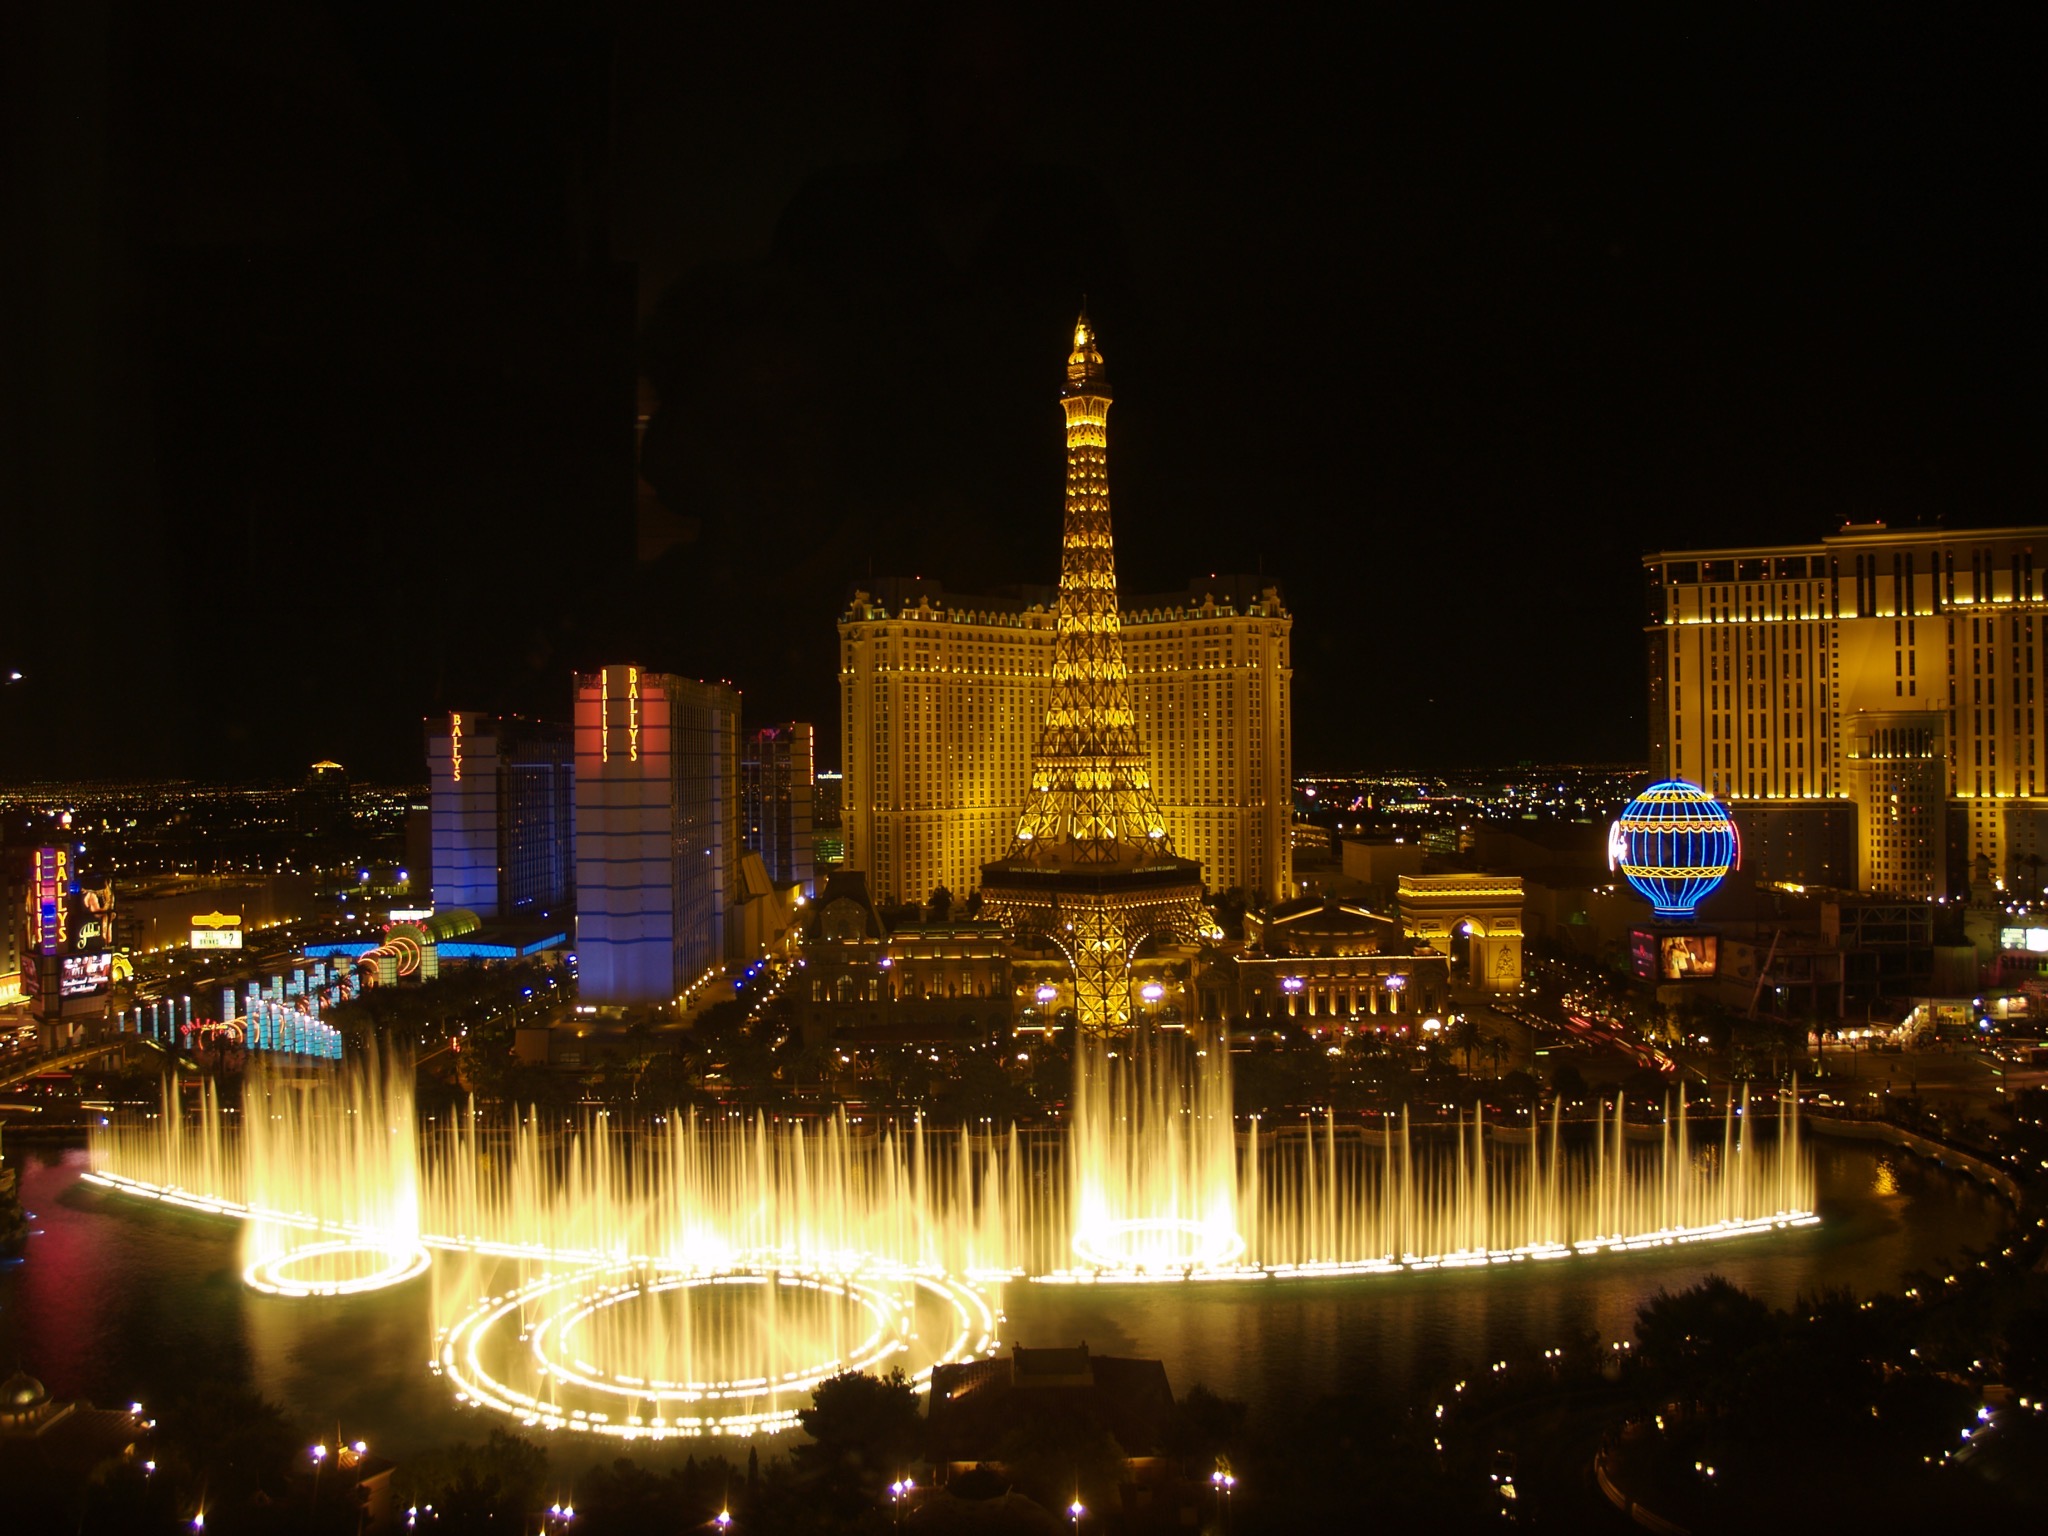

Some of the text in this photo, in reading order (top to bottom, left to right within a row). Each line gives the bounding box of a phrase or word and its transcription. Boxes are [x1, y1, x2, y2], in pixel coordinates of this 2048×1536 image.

[451, 714, 462, 782] BALLYS
[628, 667, 639, 762] BALLYS
[56, 851, 68, 943] BALLYS
